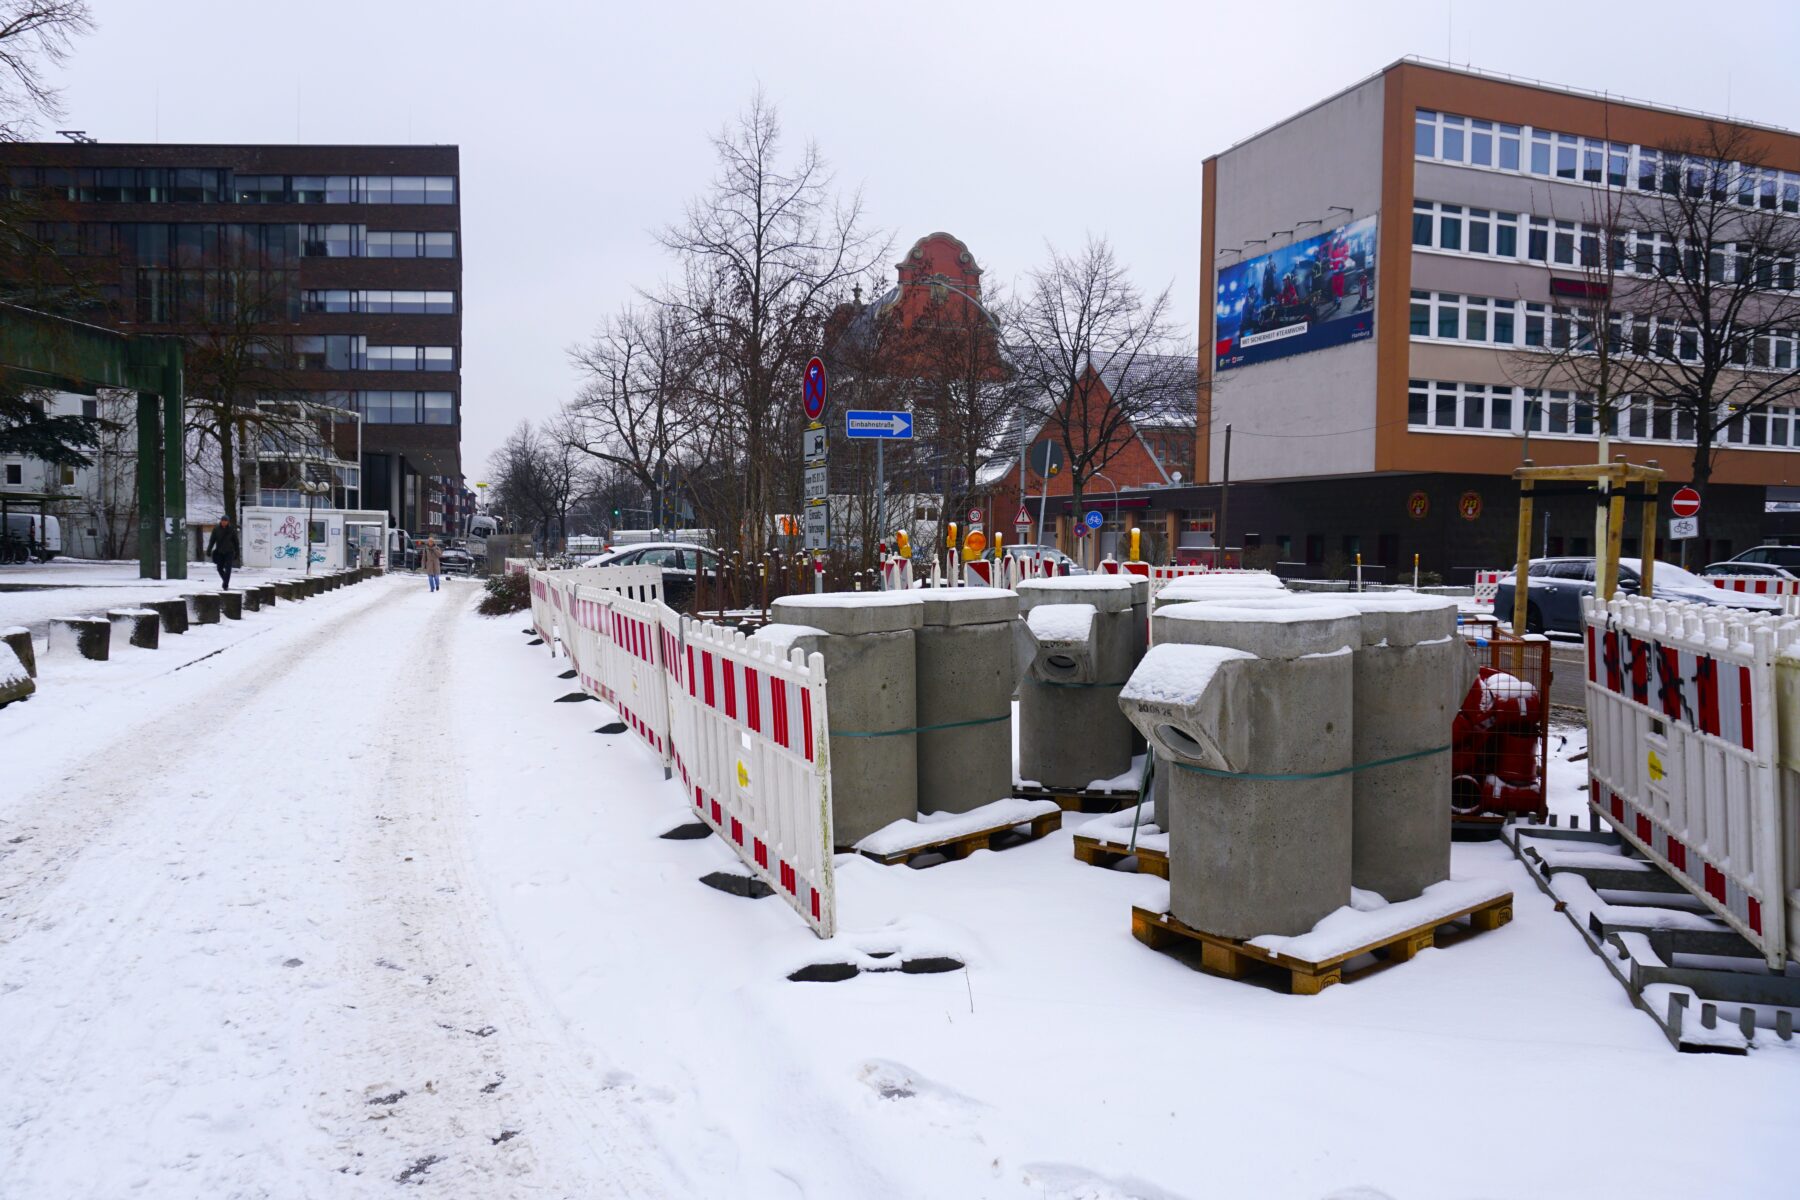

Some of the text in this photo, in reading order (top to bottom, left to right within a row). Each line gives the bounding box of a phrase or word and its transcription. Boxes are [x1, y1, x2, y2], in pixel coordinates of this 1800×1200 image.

[1242, 325, 1305, 345] MIT SICHERHEIT #TEAMWORK
[1351, 330, 1370, 339] Hamburg
[851, 420, 894, 428] Einbahnstraße
[971, 511, 980, 519] 30
